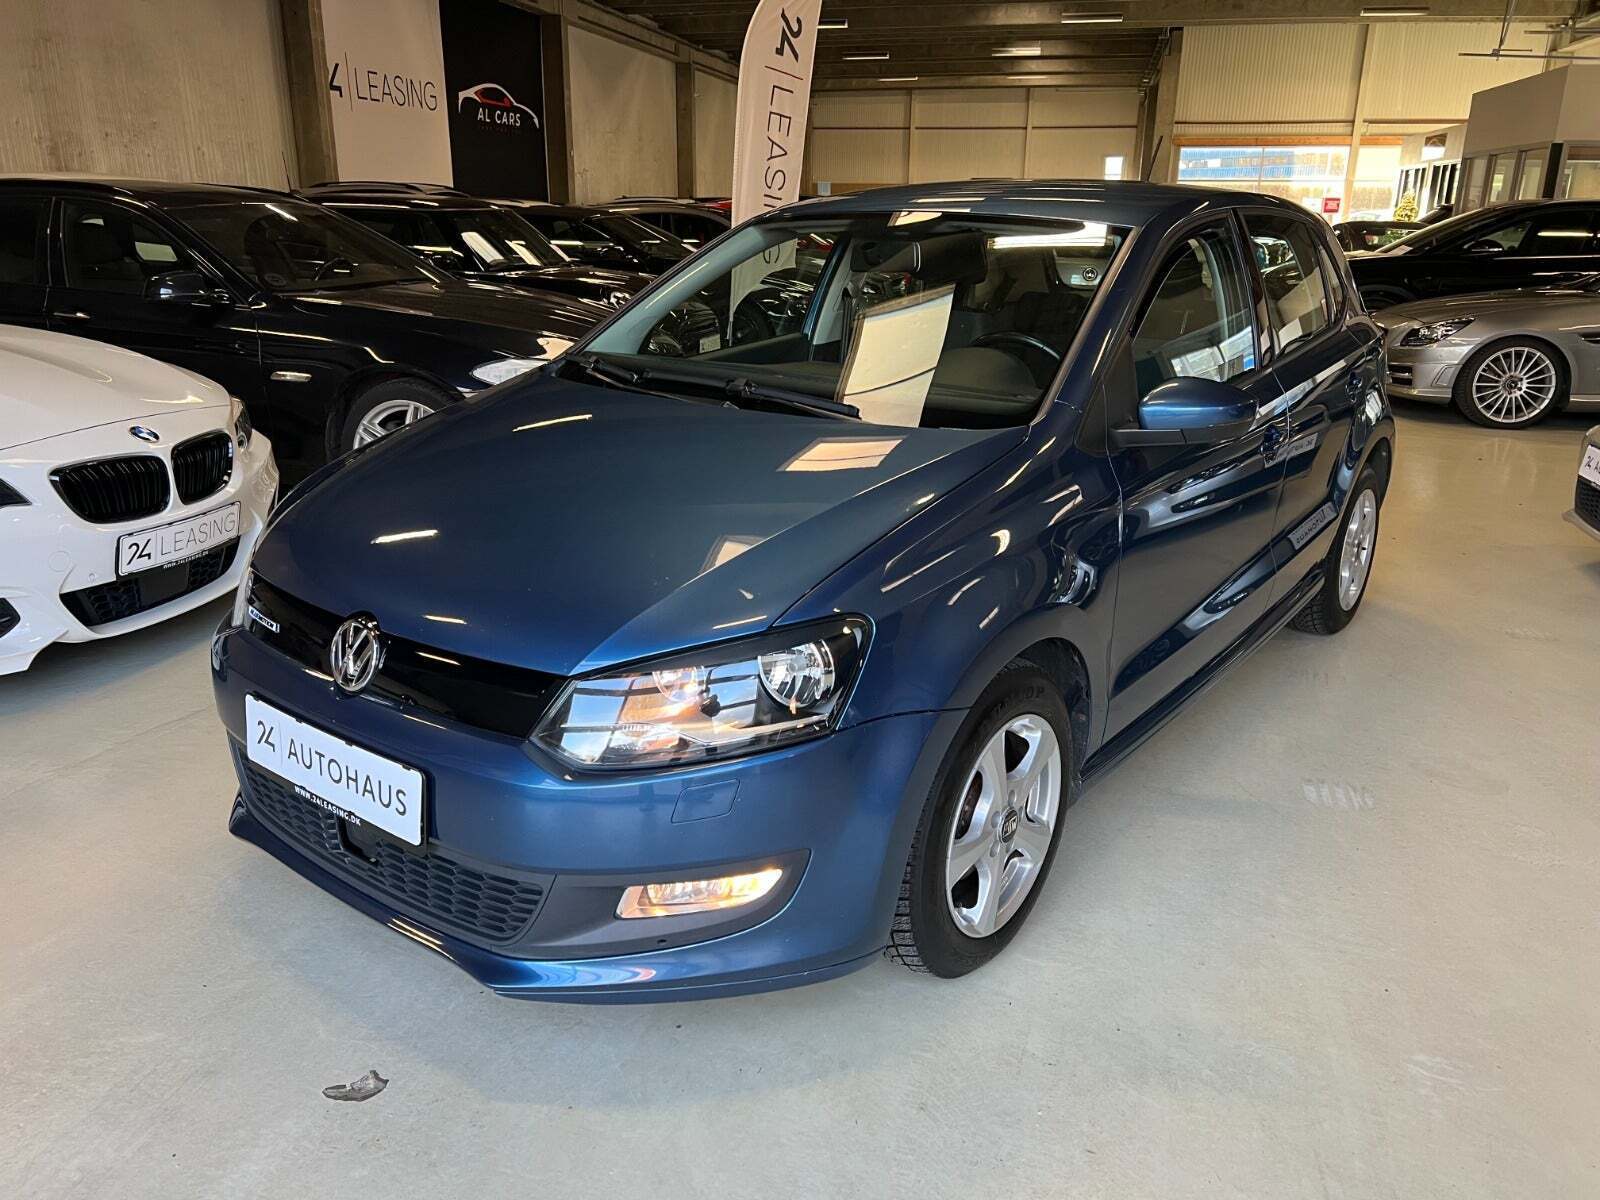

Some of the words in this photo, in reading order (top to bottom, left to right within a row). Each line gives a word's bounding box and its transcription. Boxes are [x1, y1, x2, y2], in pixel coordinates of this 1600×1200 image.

[775, 8, 803, 63] 24
[354, 67, 438, 111] LEASING
[477, 107, 491, 123] AL
[495, 110, 520, 127] CARS
[762, 85, 793, 265] LEASIG
[127, 538, 152, 566] 24
[160, 512, 236, 556] LEASING
[257, 719, 276, 753] 24
[287, 737, 408, 816] AUTOHAUS
[294, 784, 362, 827] WWW.24LEASING.DK
